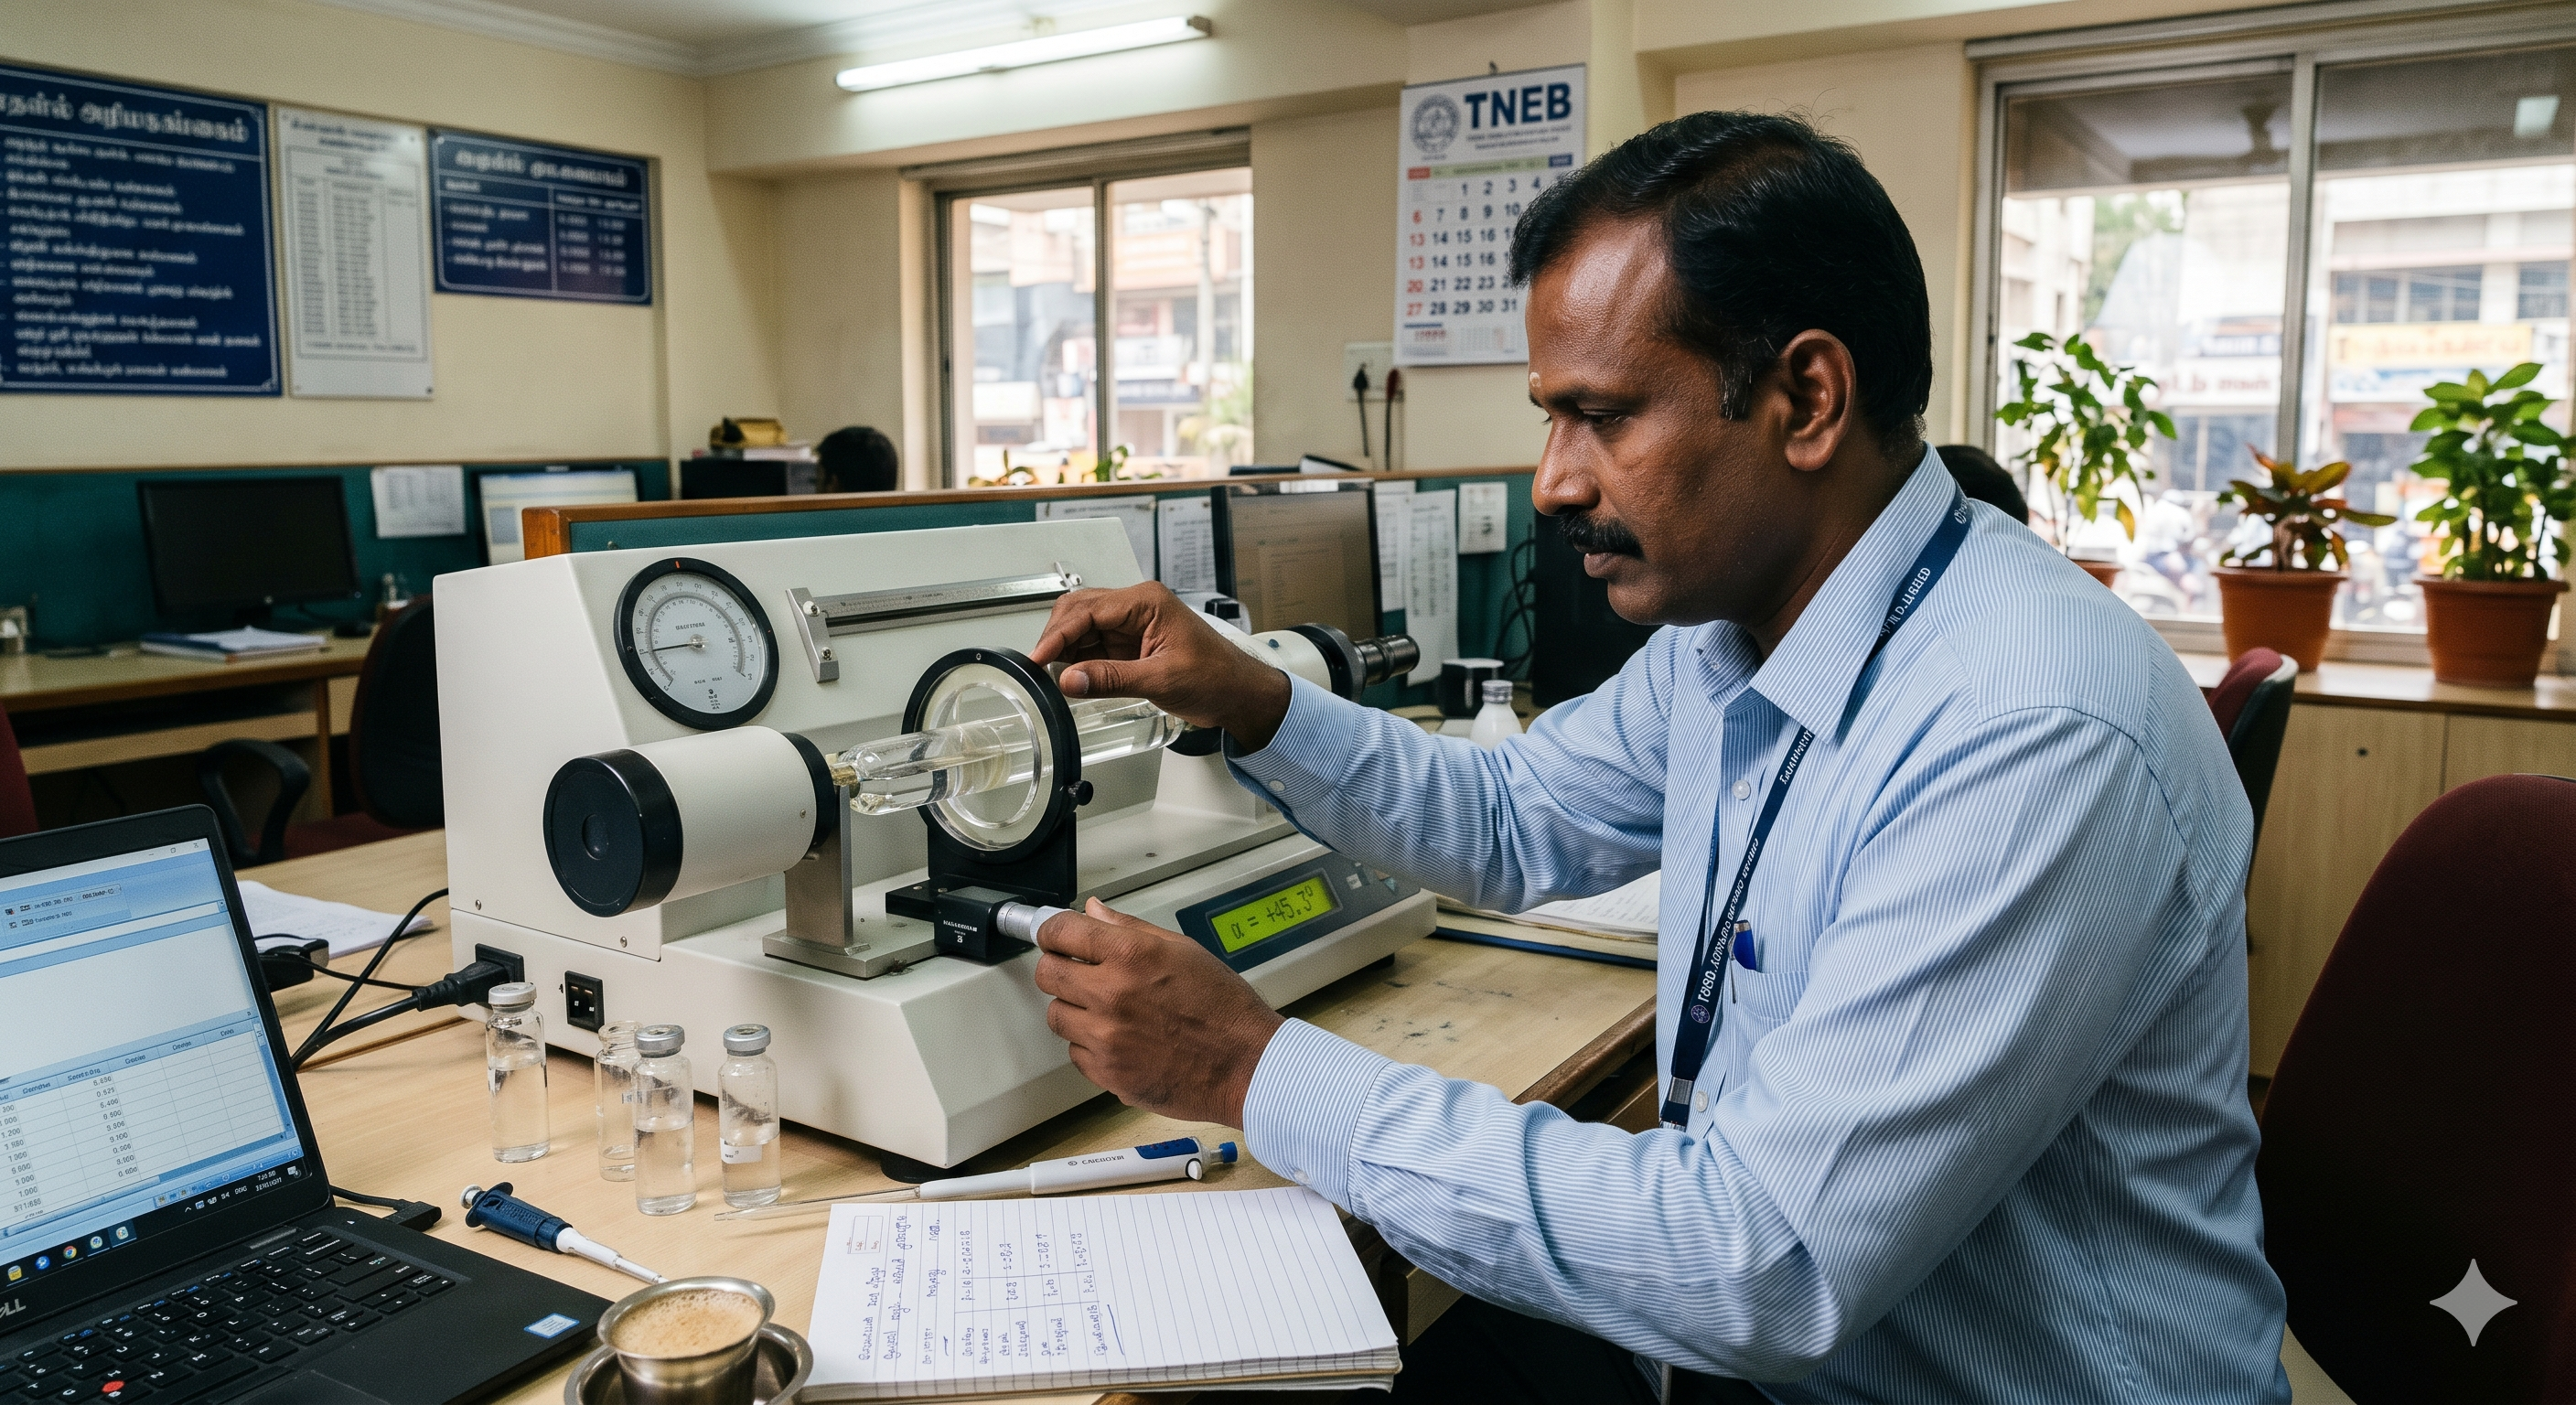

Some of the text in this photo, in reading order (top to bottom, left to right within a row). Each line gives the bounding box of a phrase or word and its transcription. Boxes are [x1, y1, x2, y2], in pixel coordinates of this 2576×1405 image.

[1465, 82, 1572, 130] TNEB
[1462, 177, 1540, 196] 1 2 3 4
[1412, 202, 1520, 224] 6 7 8 9 10
[1410, 233, 1425, 247] 13
[1433, 231, 1448, 244] 14
[1456, 230, 1472, 243] 15
[1480, 229, 1496, 242] 16
[1409, 256, 1425, 270] 13
[1432, 255, 1448, 268] 14
[1456, 253, 1472, 267] 15
[1479, 252, 1496, 265] 16
[1430, 278, 1446, 292] 21
[1454, 276, 1471, 291] 22
[1477, 275, 1495, 290] 23
[1406, 299, 1517, 316] 27 28 29 30 31
